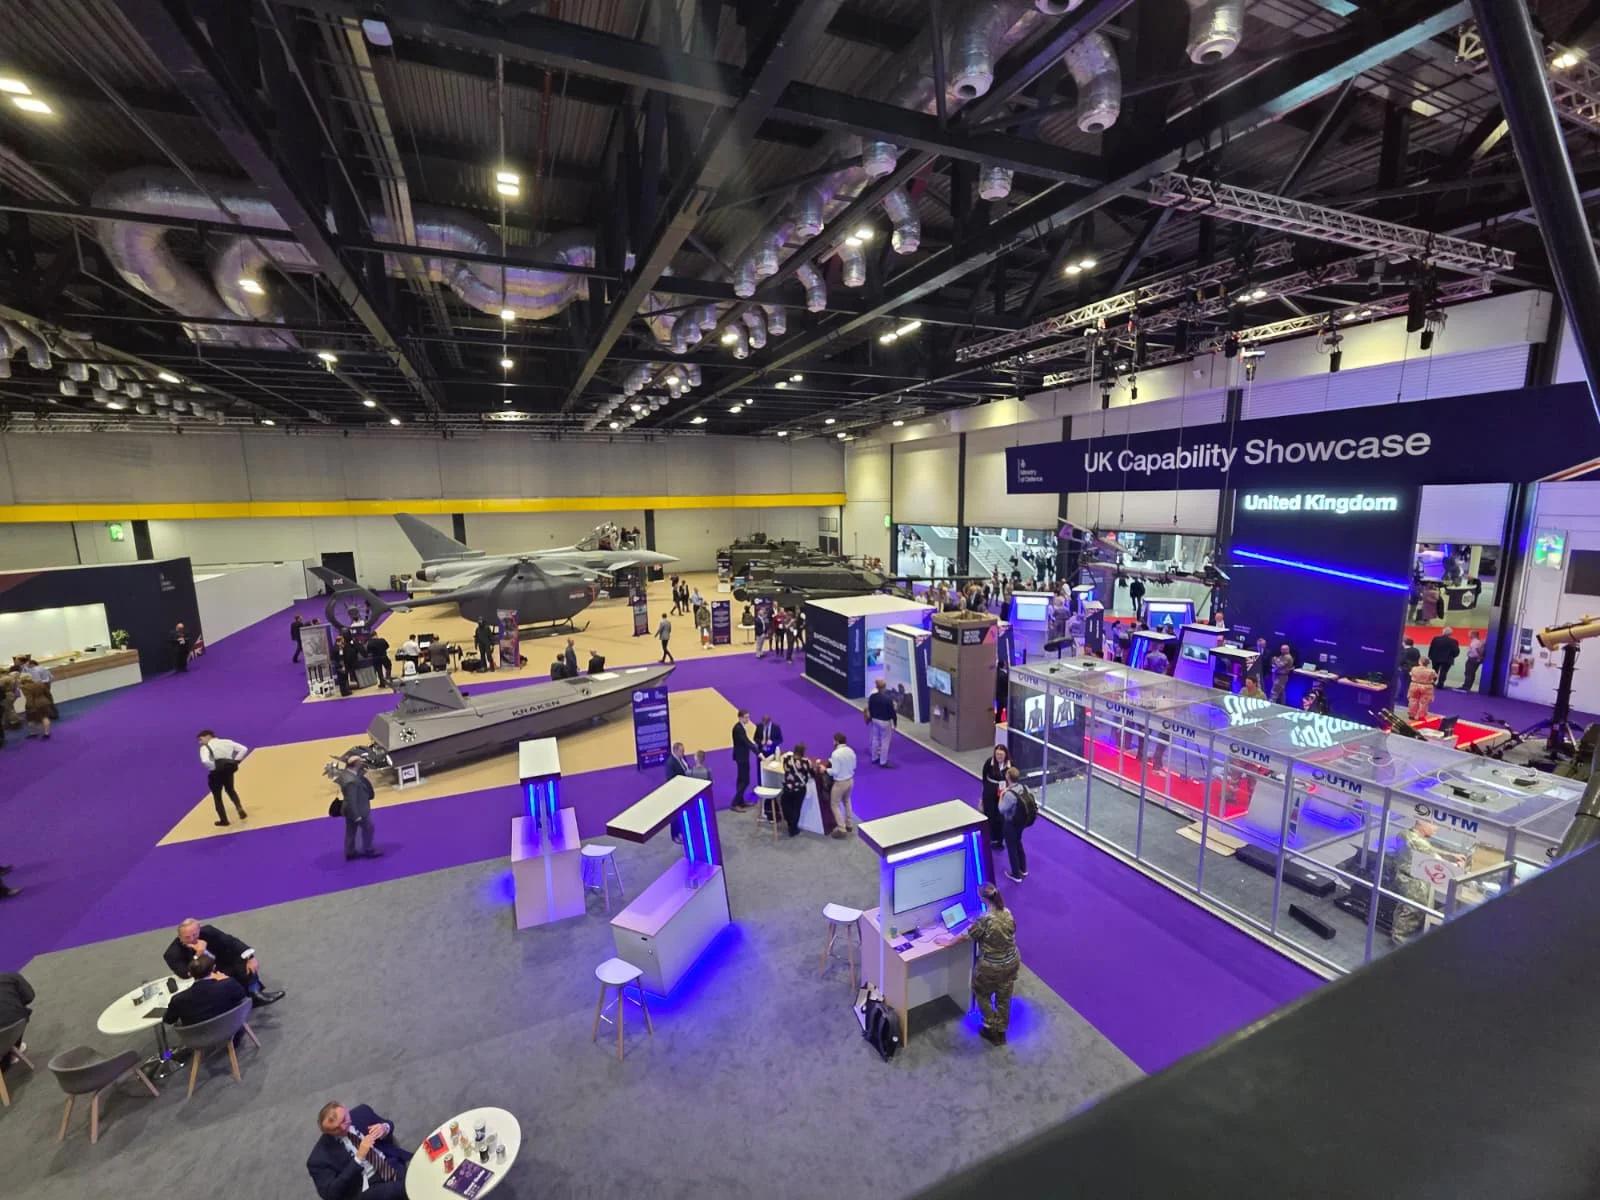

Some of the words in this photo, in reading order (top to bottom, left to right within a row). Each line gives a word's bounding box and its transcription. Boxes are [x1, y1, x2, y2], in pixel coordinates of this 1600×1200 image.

[1084, 450, 1113, 473] UK
[1117, 443, 1238, 476] Capability
[1244, 432, 1432, 465] Showcase
[1244, 494, 1302, 511] United
[1304, 493, 1398, 514] Kingdom
[1024, 674, 1039, 686] UTM
[1066, 690, 1083, 701] UTM
[512, 700, 560, 717] KRAKEN
[1114, 704, 1134, 717] UTM
[1172, 726, 1196, 739] UTM
[1241, 747, 1270, 764] UTM
[1326, 775, 1362, 794] UTM
[1433, 810, 1479, 833] UTM
